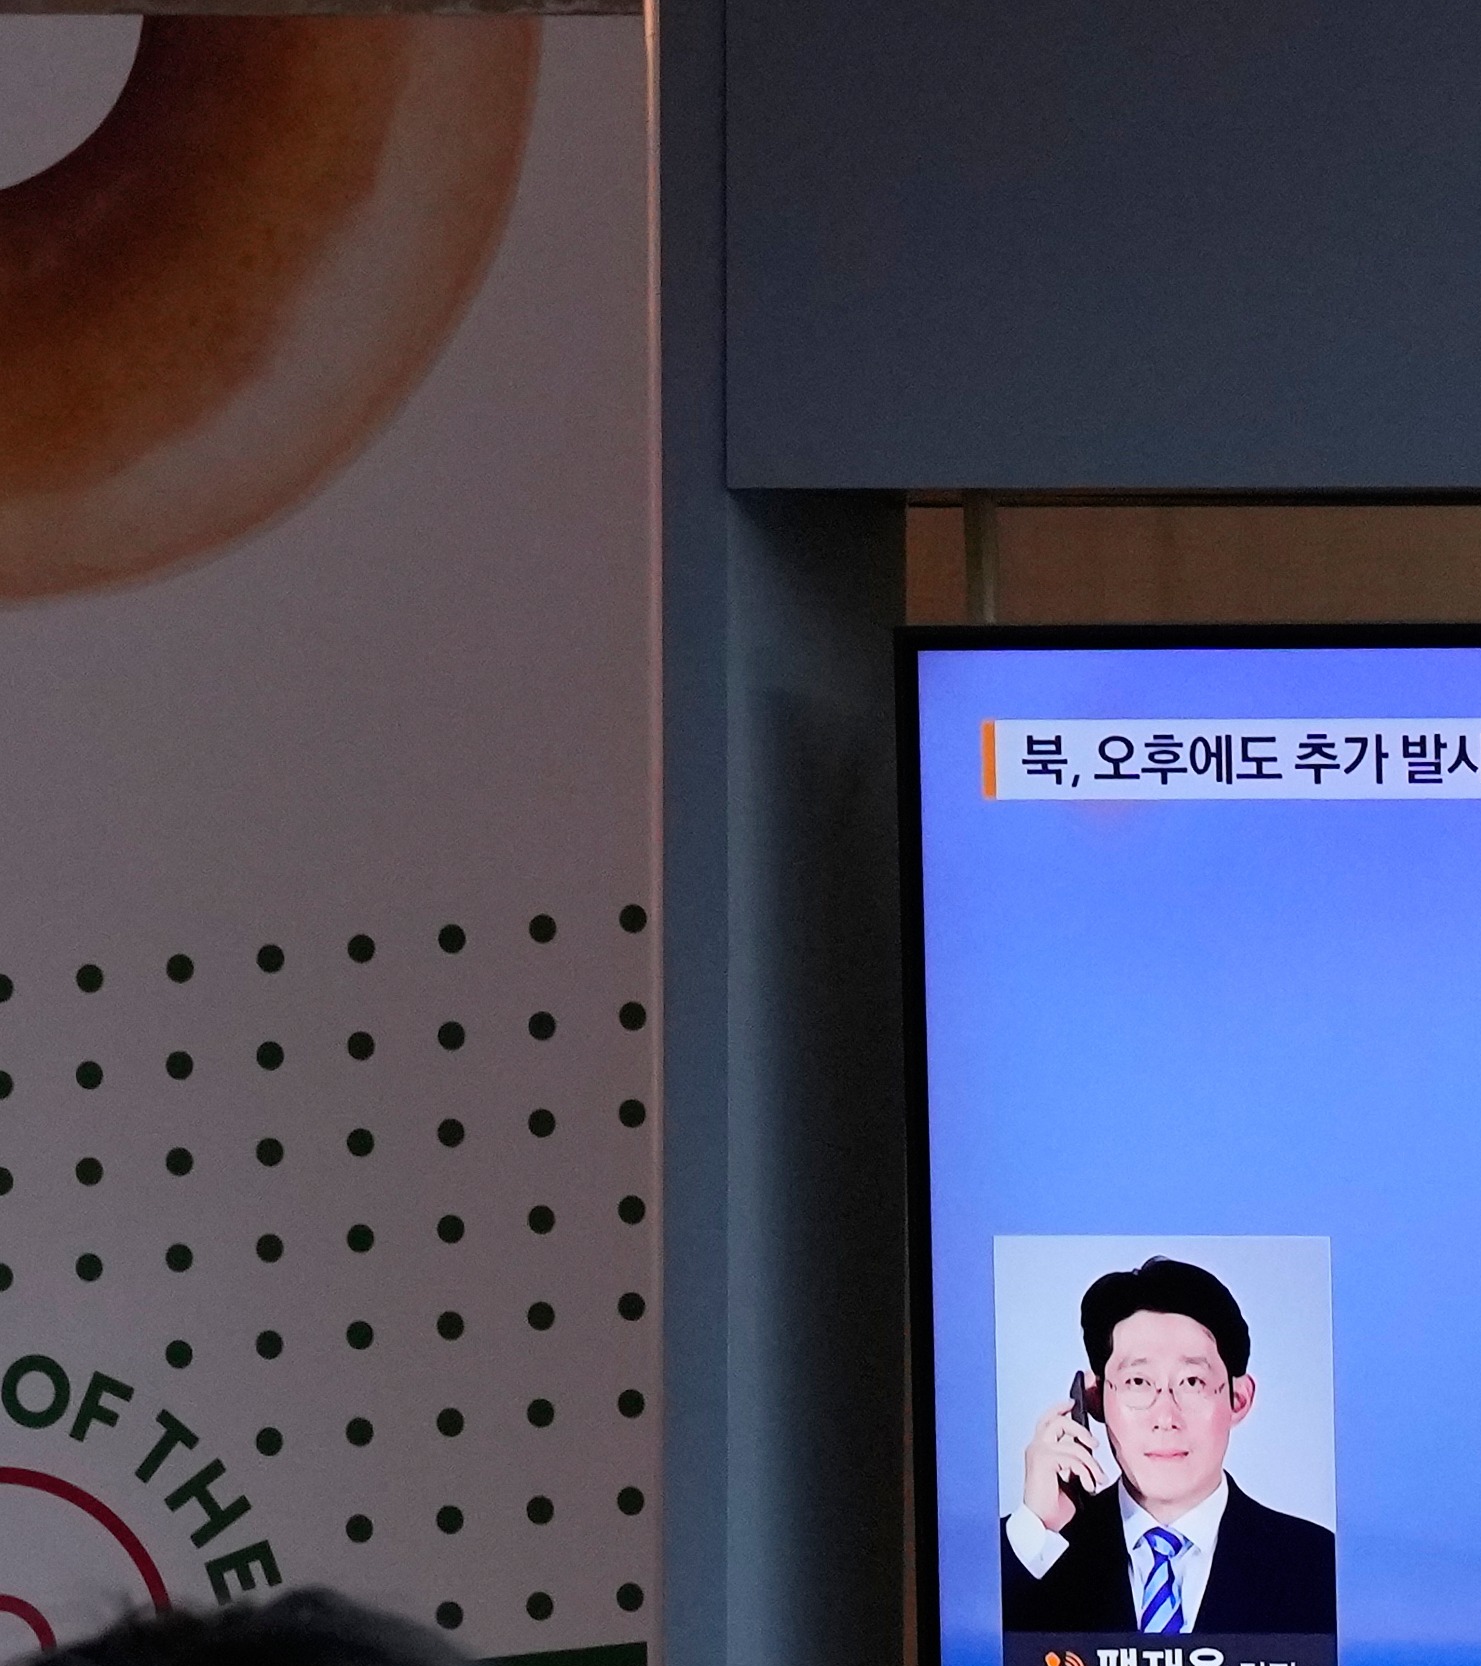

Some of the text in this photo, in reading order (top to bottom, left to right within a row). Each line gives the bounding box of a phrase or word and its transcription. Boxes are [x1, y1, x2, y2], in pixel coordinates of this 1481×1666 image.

[1021, 734, 1080, 788] 북,
[1093, 734, 1283, 786] 오후에도
[1294, 733, 1390, 785] 추가
[1, 1354, 283, 1606] OF THE
